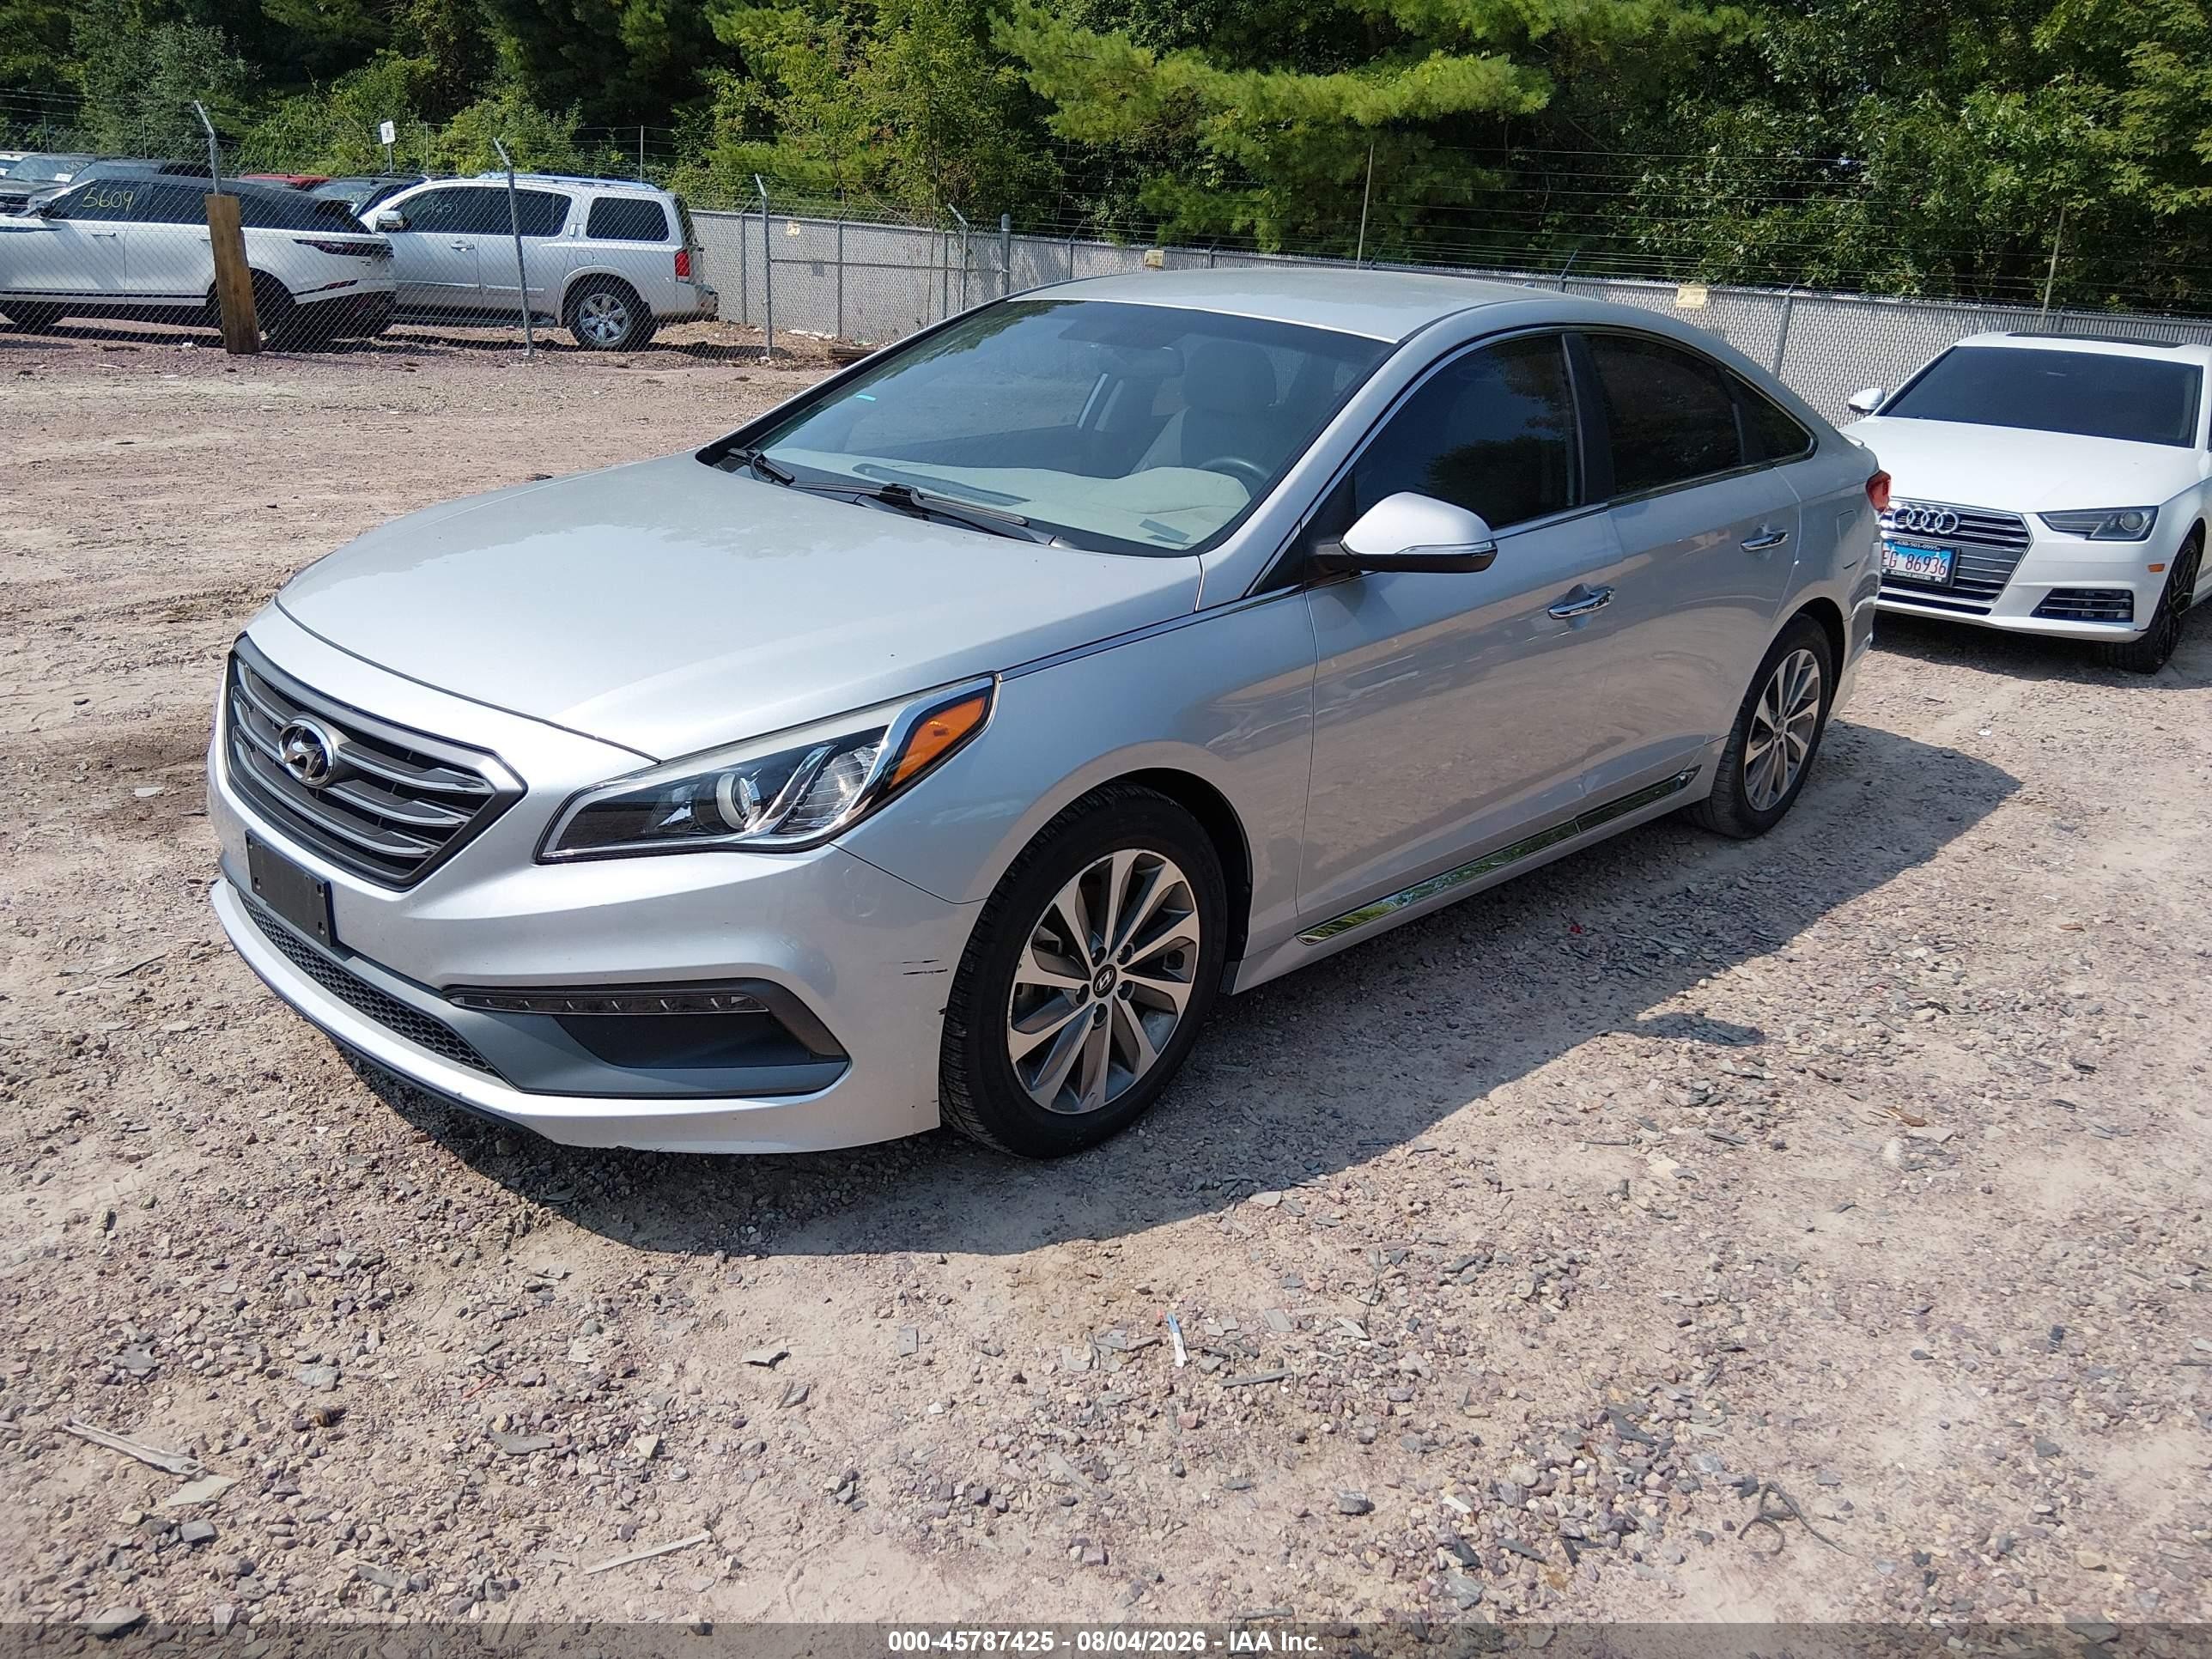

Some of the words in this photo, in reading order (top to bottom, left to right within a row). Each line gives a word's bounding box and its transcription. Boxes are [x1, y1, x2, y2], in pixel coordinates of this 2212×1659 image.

[82, 186, 133, 212] 5609
[1882, 550, 1899, 568] EG
[1905, 553, 1948, 576] 86936
